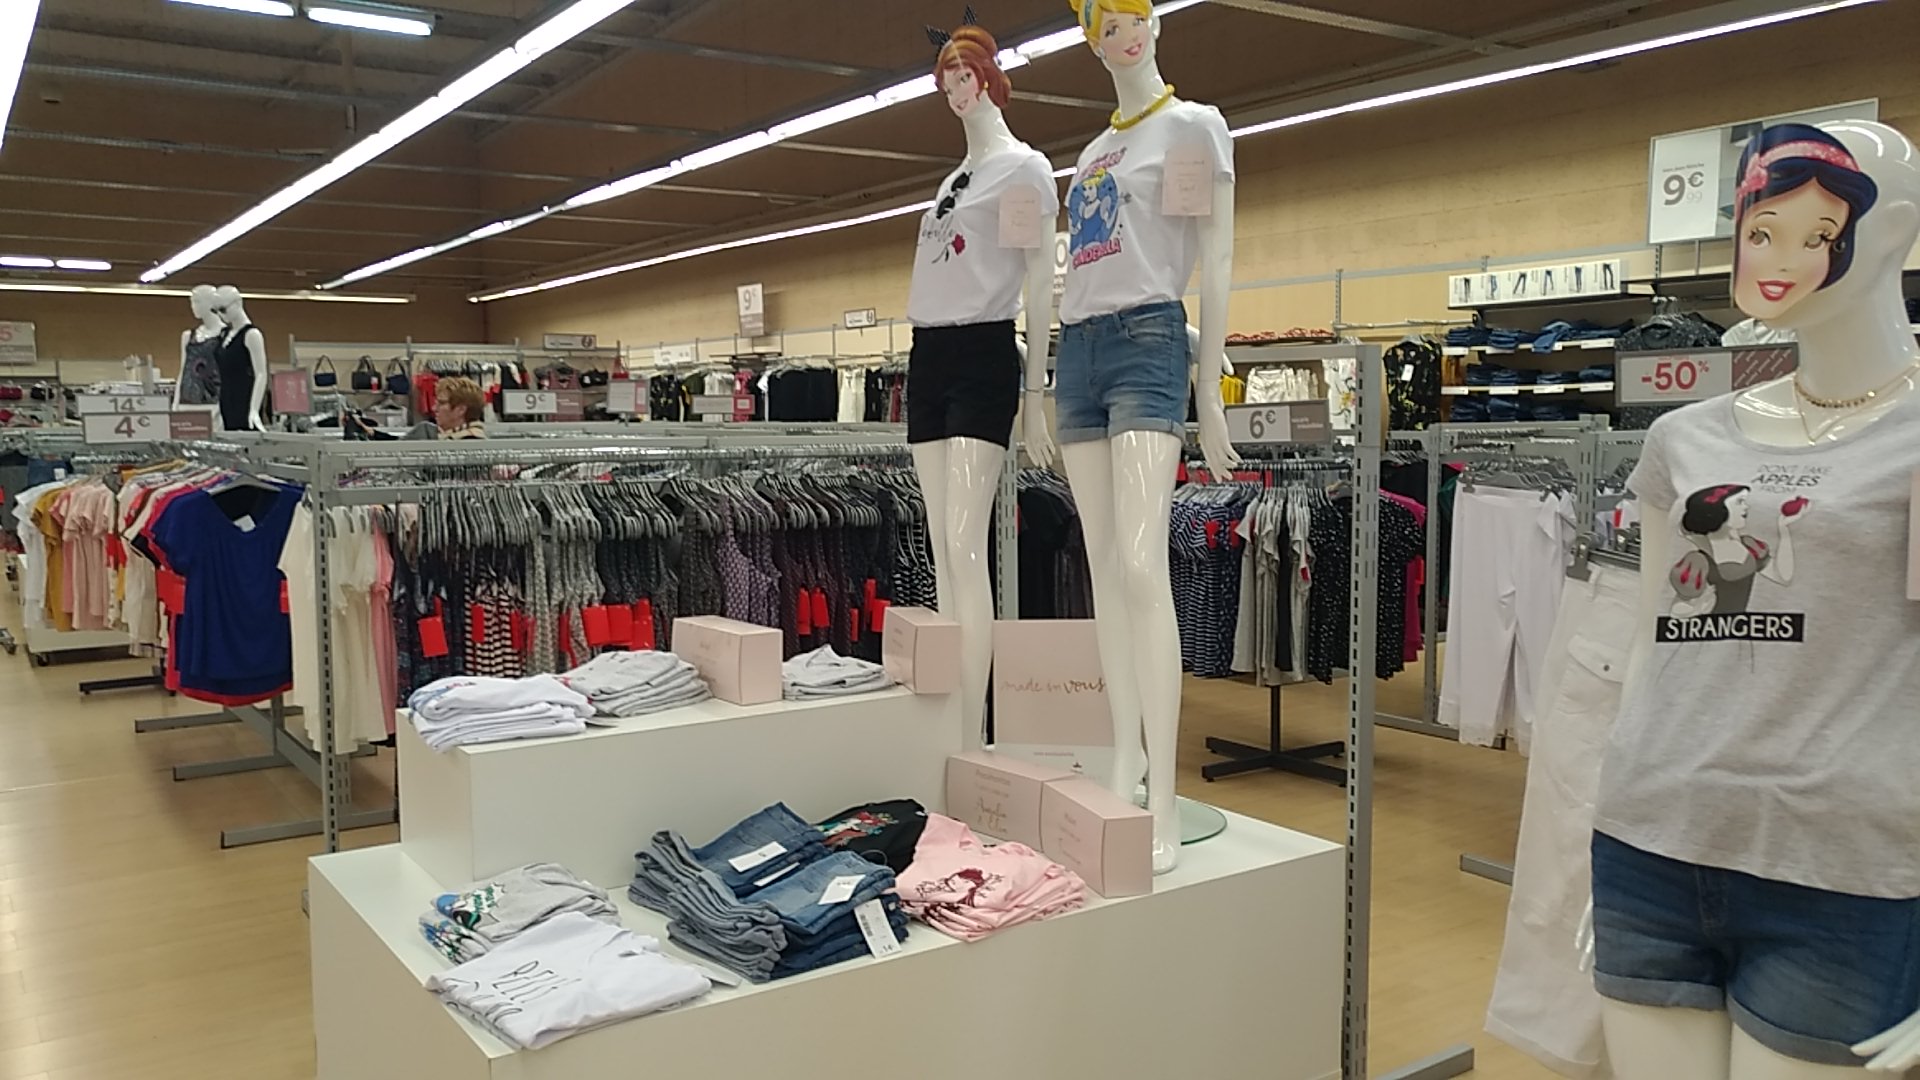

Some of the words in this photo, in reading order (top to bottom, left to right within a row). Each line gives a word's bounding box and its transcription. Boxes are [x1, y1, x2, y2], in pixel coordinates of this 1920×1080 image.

[1641, 360, 1709, 391] -50%
[115, 415, 151, 438] 4€
[1249, 409, 1276, 439] 6€
[1750, 473, 1821, 487] APPLES
[1664, 614, 1795, 640] STRANGERS
